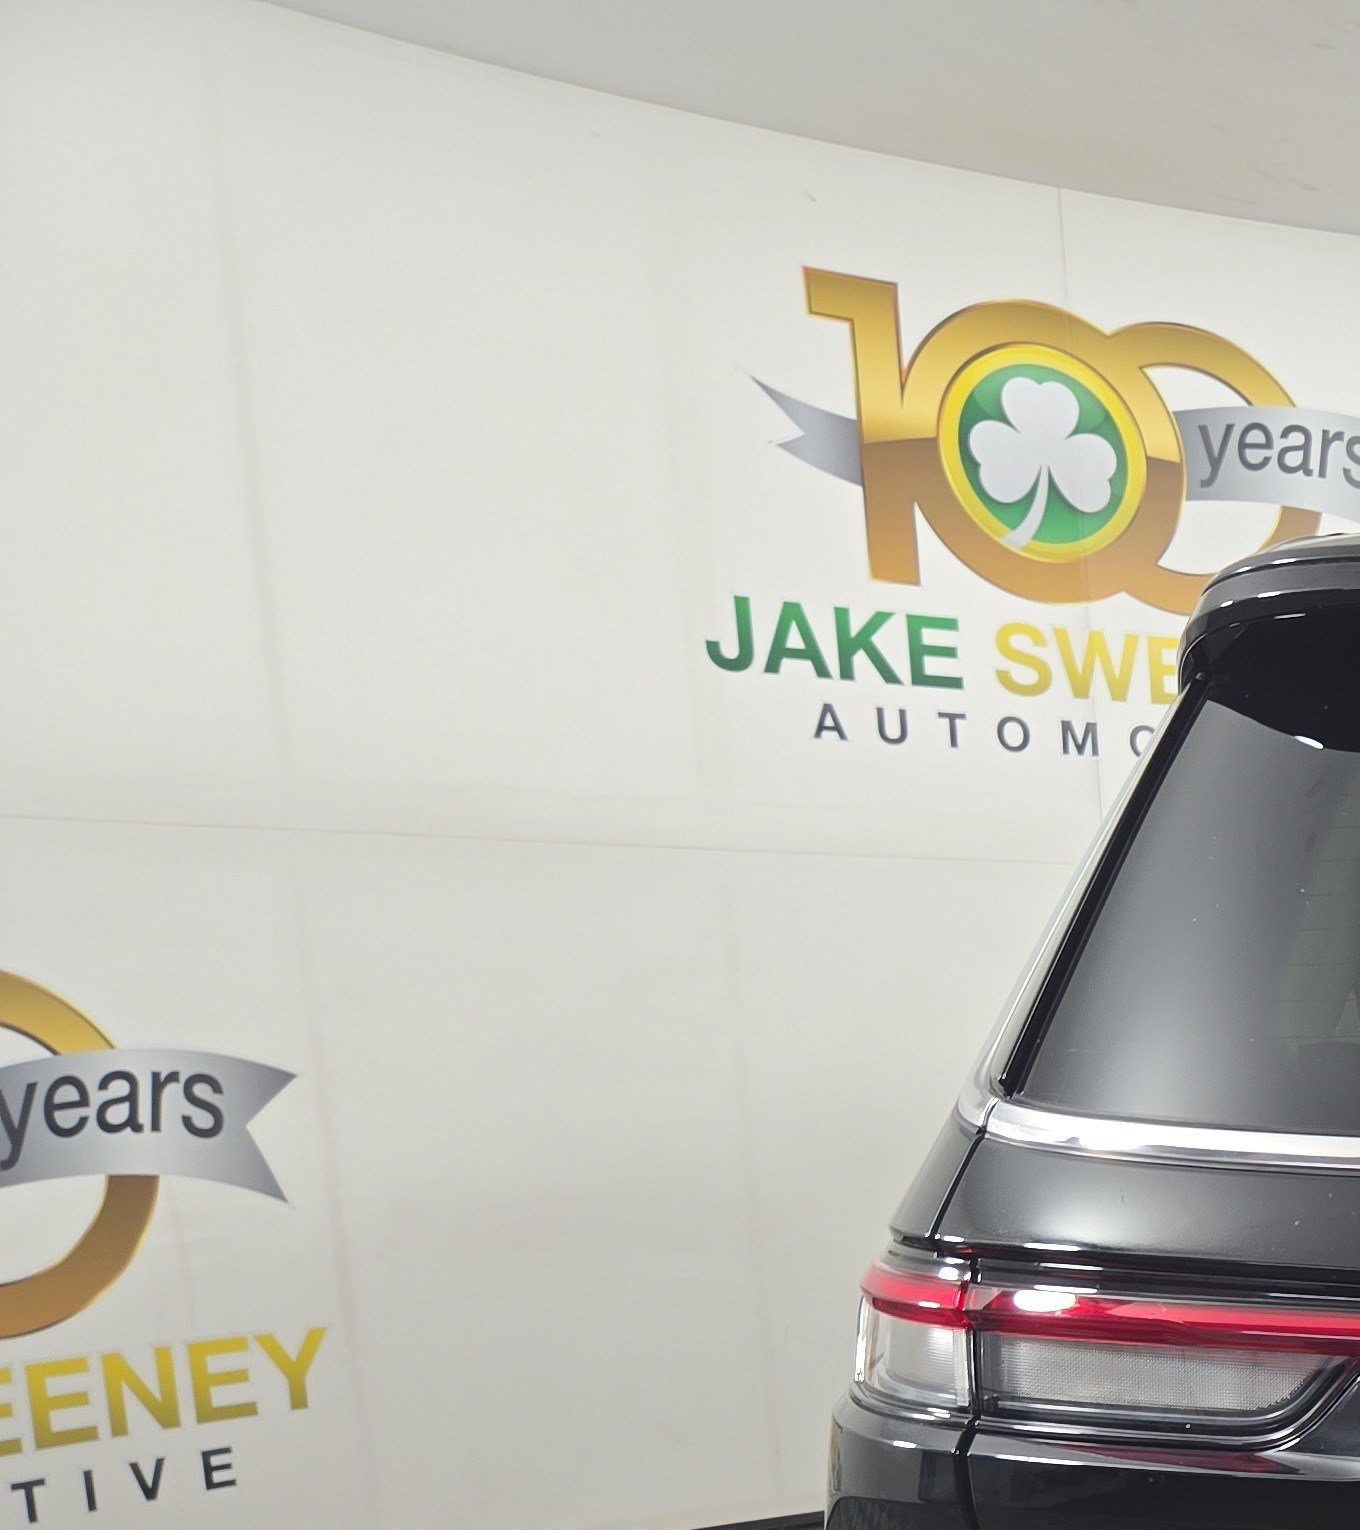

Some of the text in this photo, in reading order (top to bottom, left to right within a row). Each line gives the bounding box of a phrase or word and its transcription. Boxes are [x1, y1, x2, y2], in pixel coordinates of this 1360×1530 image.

[802, 266, 1321, 616] 100
[706, 596, 964, 690] JAKE
[0, 1070, 224, 1170] years
